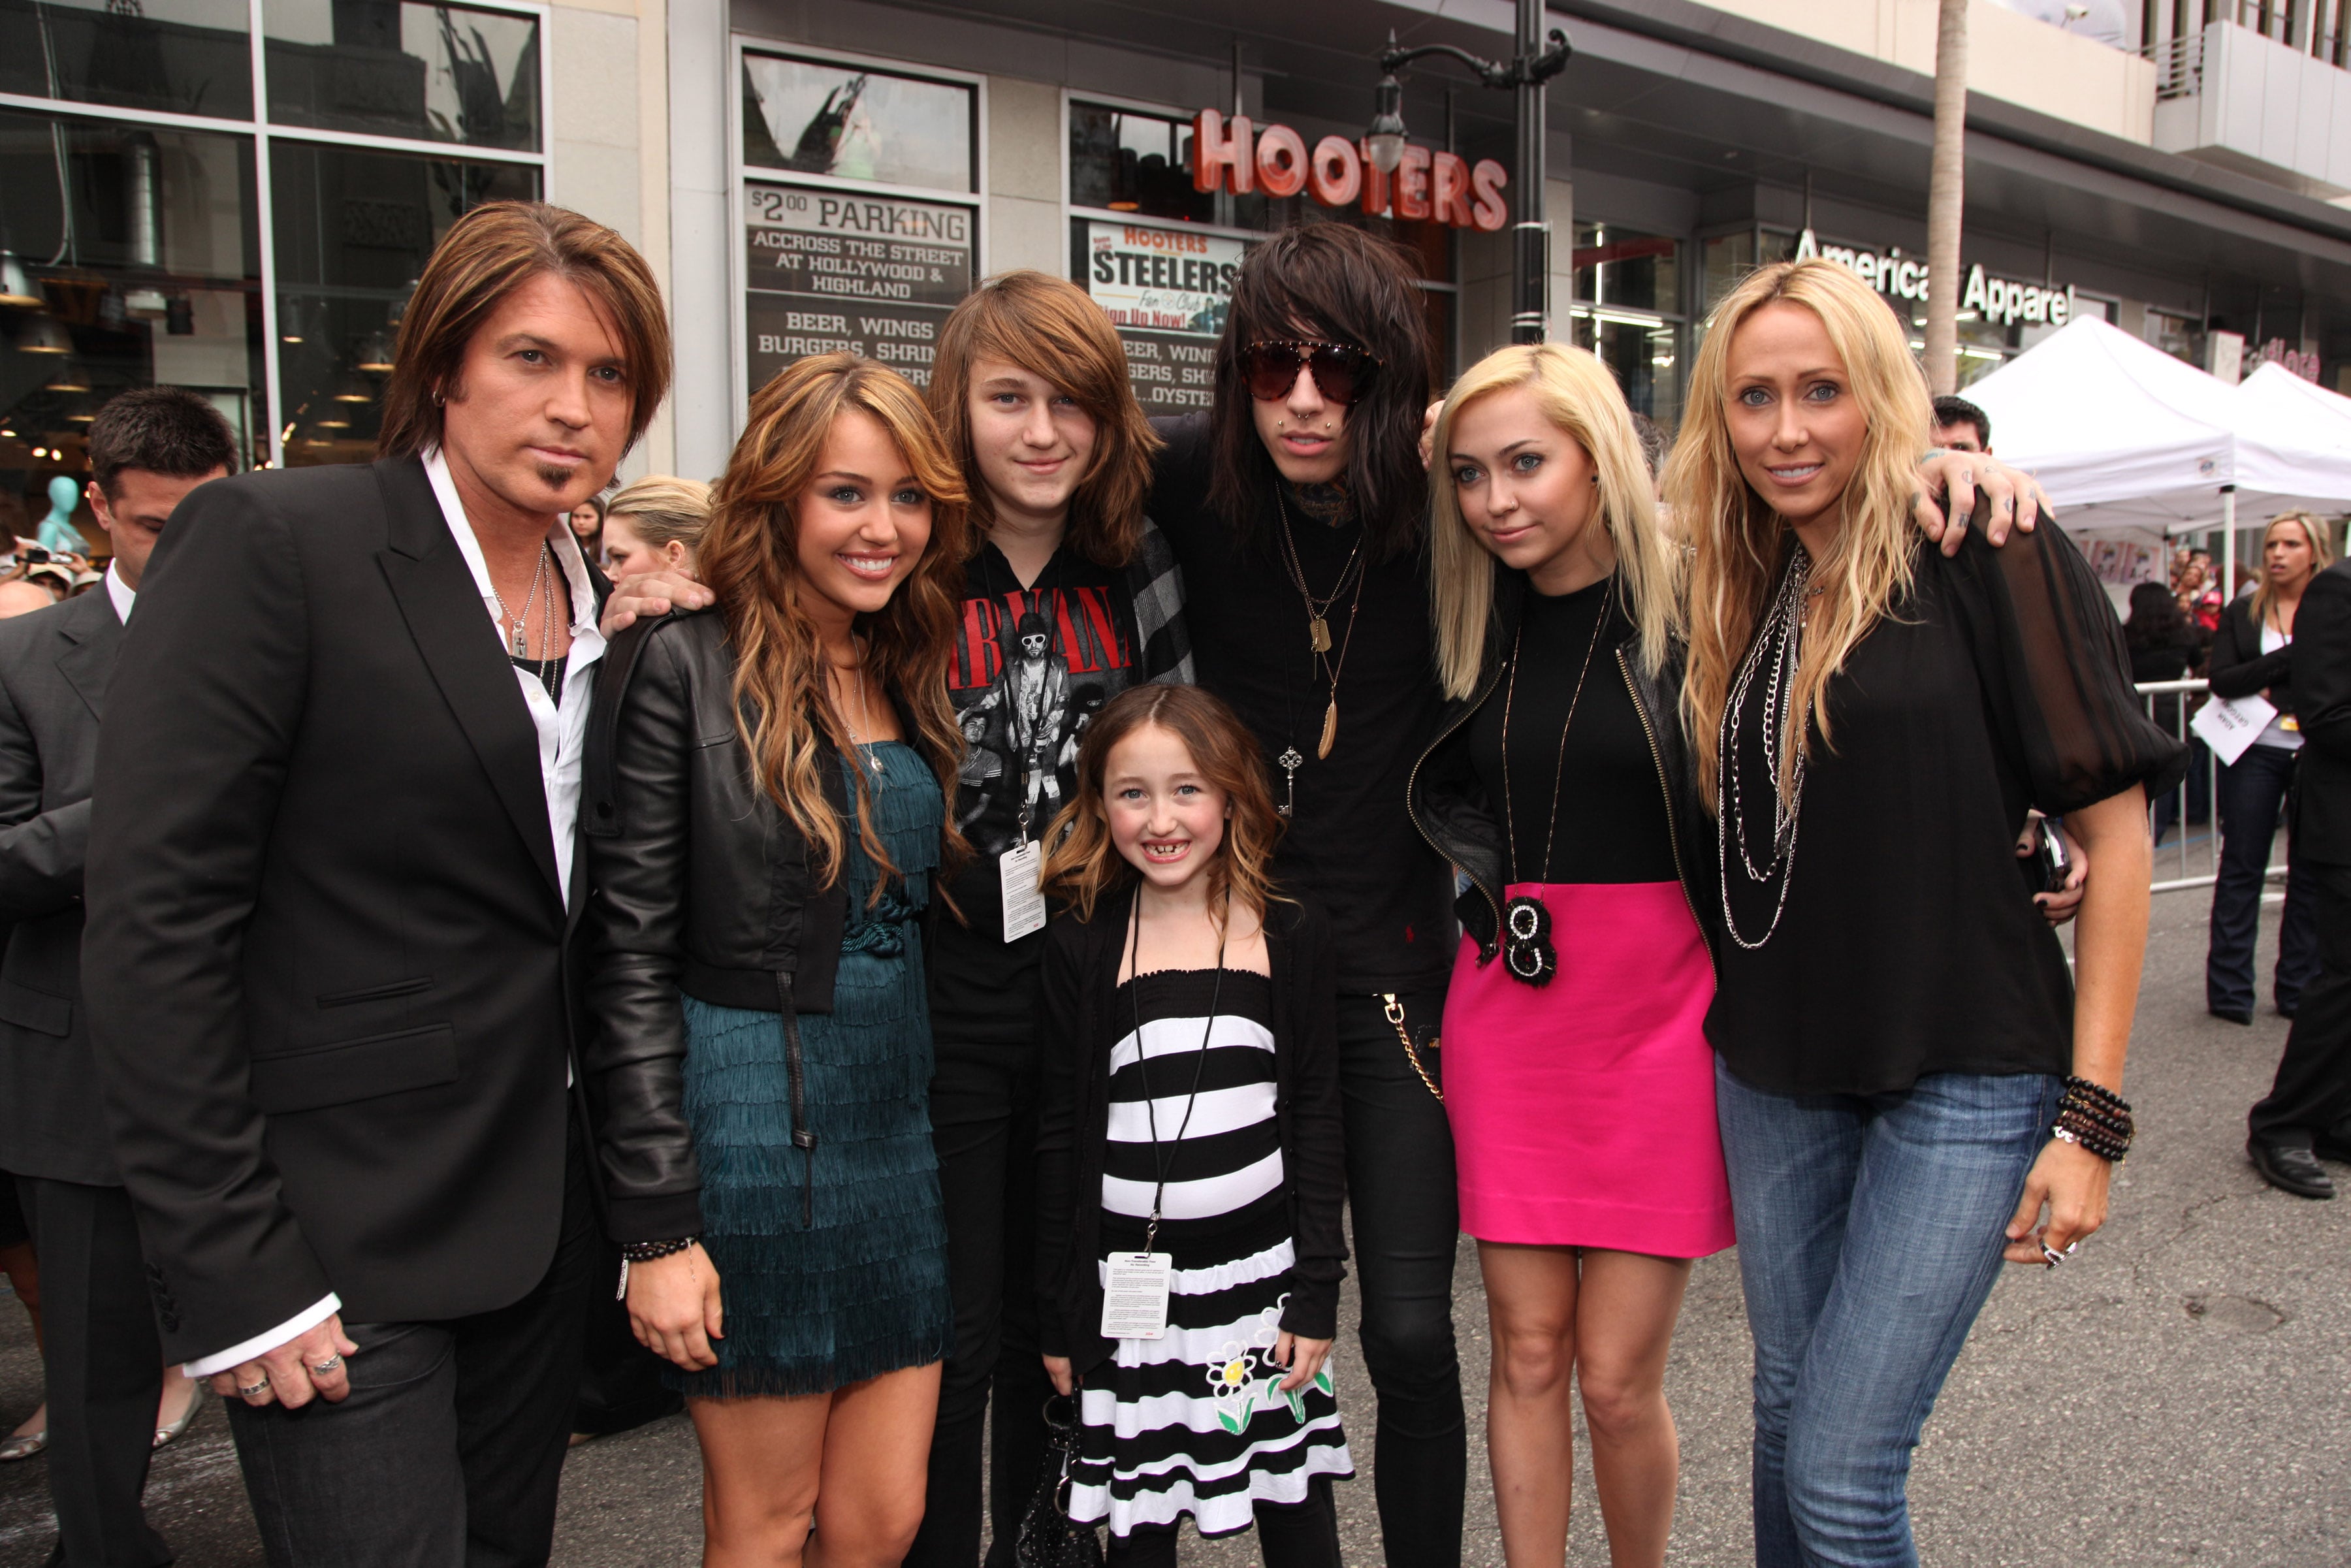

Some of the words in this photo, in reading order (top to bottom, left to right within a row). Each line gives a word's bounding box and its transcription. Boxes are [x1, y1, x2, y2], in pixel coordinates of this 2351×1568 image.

[1194, 108, 1507, 232] HOOTERS
[819, 198, 965, 242] PARKING
[754, 231, 840, 254] ACCROSS
[846, 240, 886, 258] THE
[890, 245, 964, 266] STREET
[1123, 225, 1207, 253] HOOTERS
[776, 253, 803, 270] AT
[808, 255, 925, 281] HOLLYWOOD
[930, 268, 943, 283] &
[1093, 250, 1238, 296] STEELERS
[812, 275, 911, 299] HIGHLAND
[1963, 263, 2075, 325] Apparel
[786, 312, 852, 336] BEER,
[859, 317, 934, 340] WINGS
[1130, 308, 1148, 327] Up
[1153, 310, 1187, 328] Now!
[1122, 340, 1162, 362] EER,
